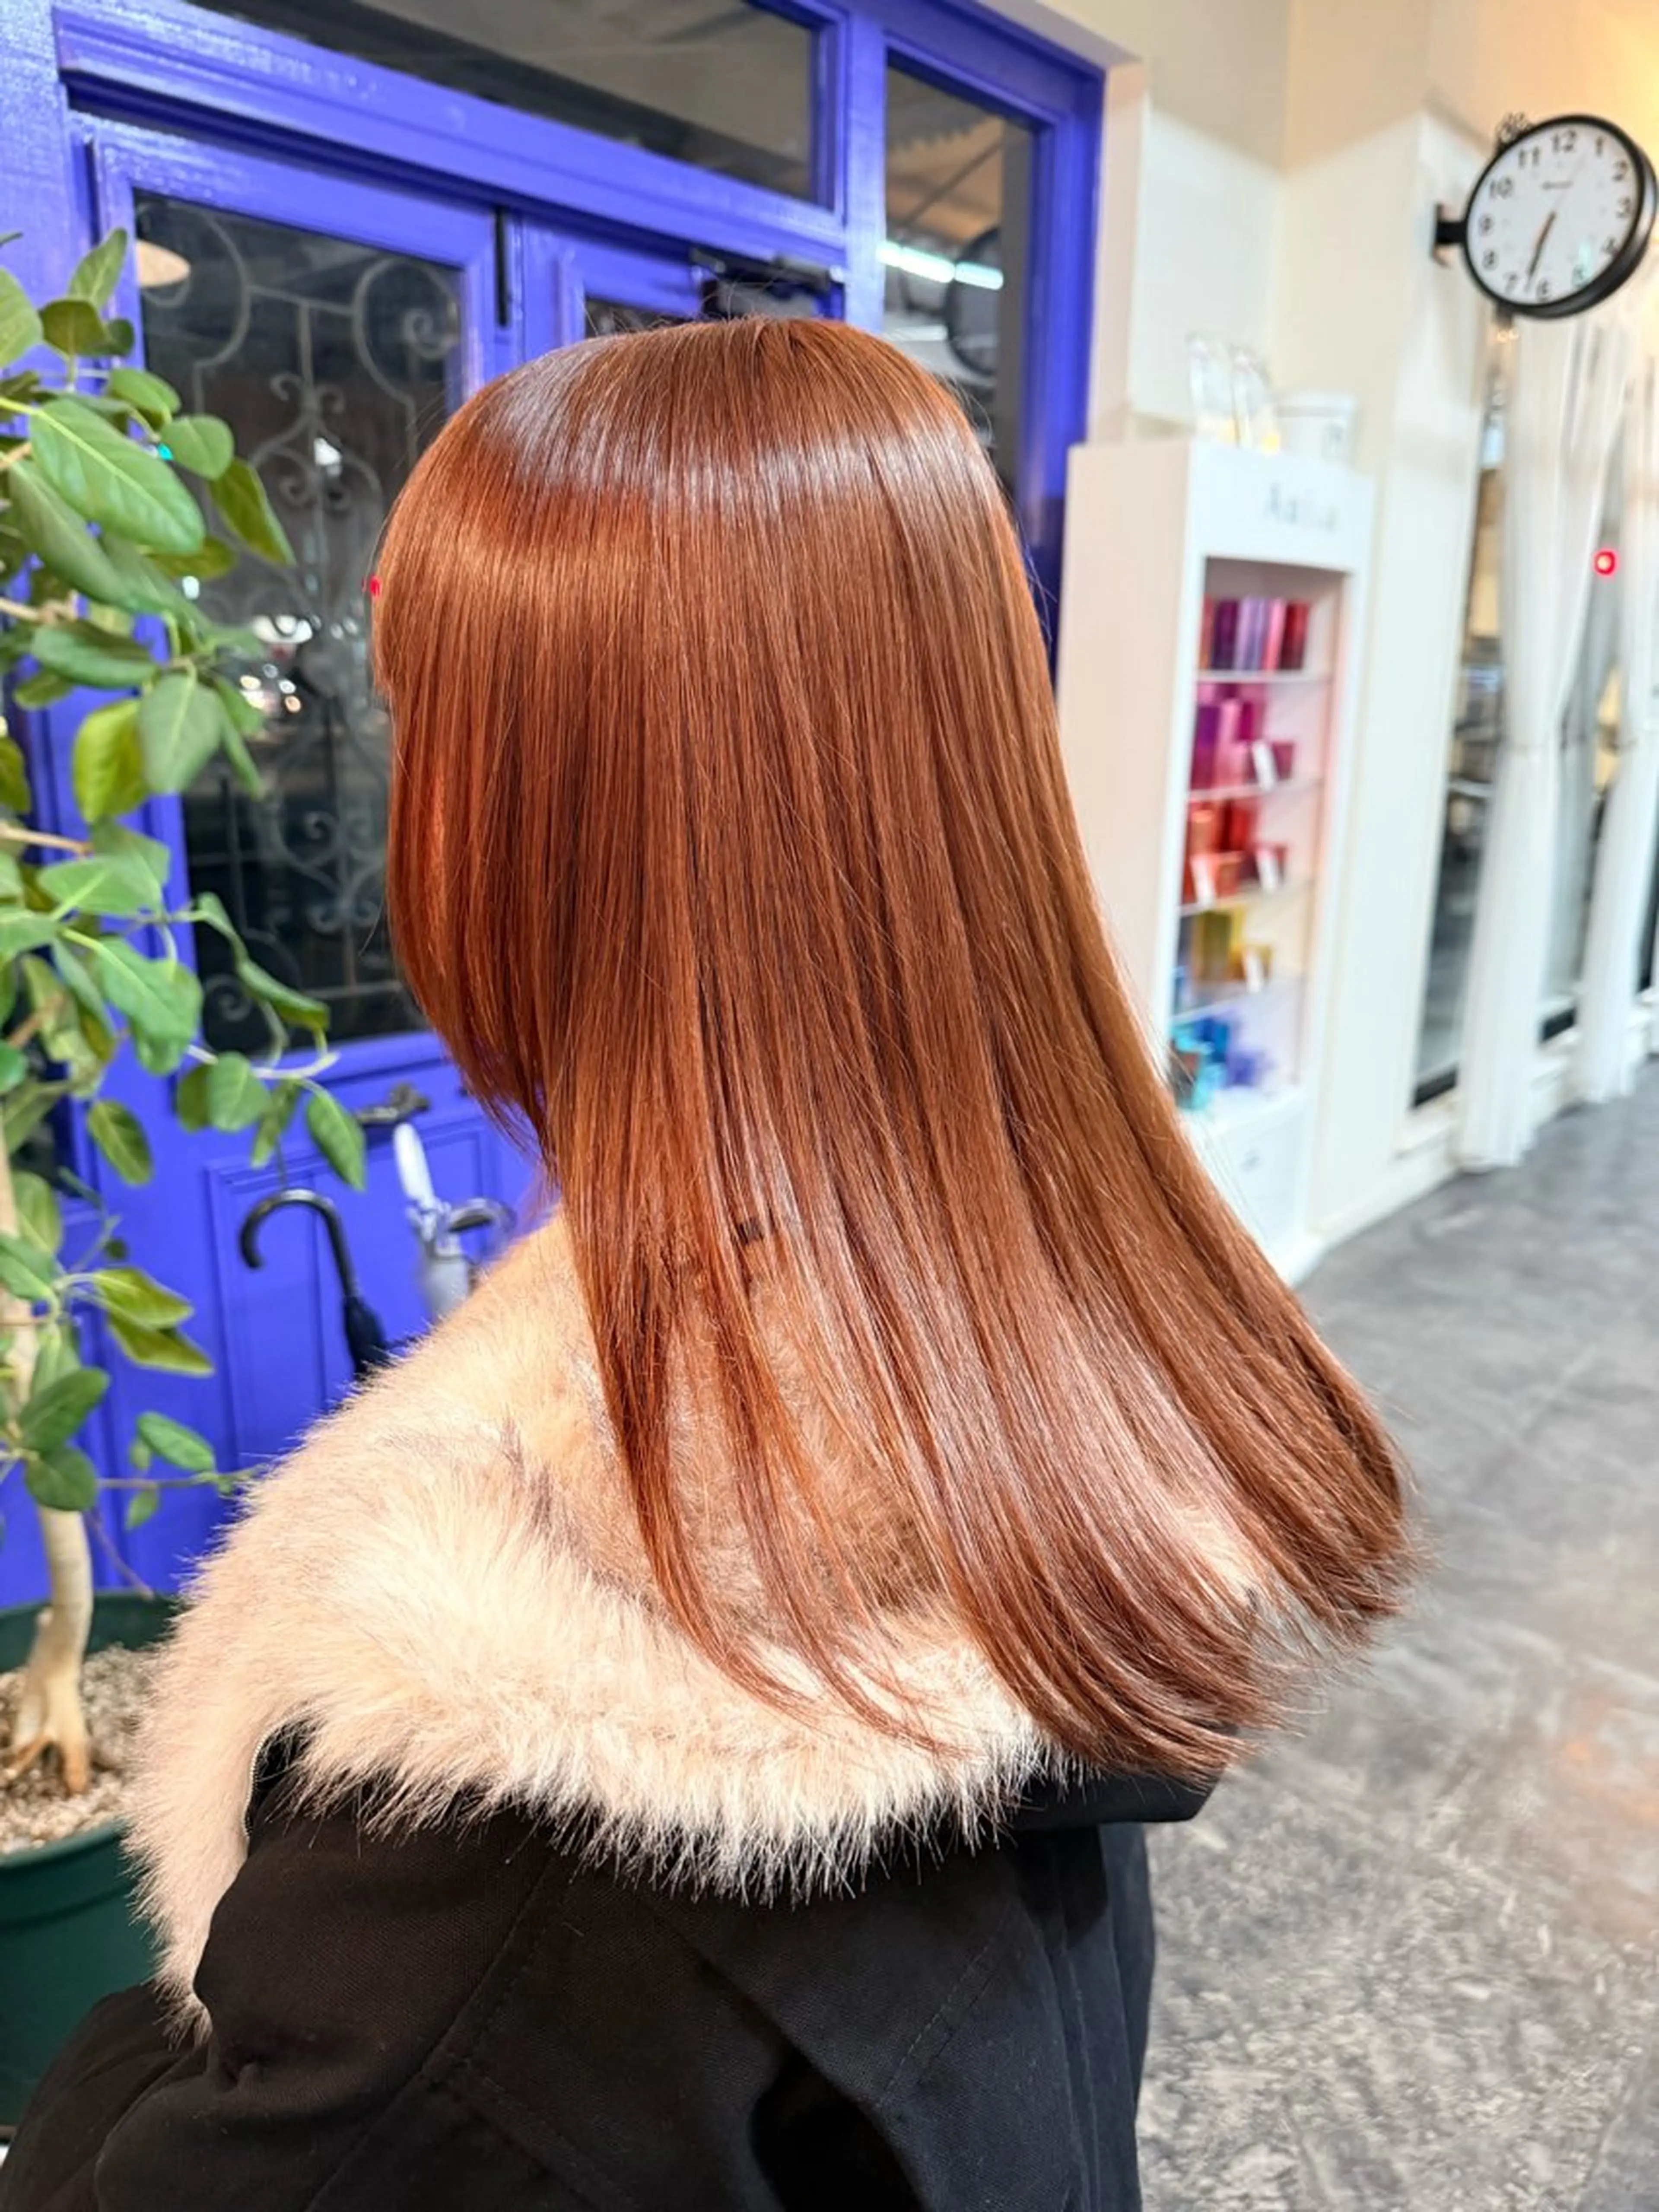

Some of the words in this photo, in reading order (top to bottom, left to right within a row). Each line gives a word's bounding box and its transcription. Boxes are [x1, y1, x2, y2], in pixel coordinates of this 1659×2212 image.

[1551, 130, 1577, 152] 12
[1518, 146, 1540, 168] 11
[1489, 177, 1513, 199] 10
